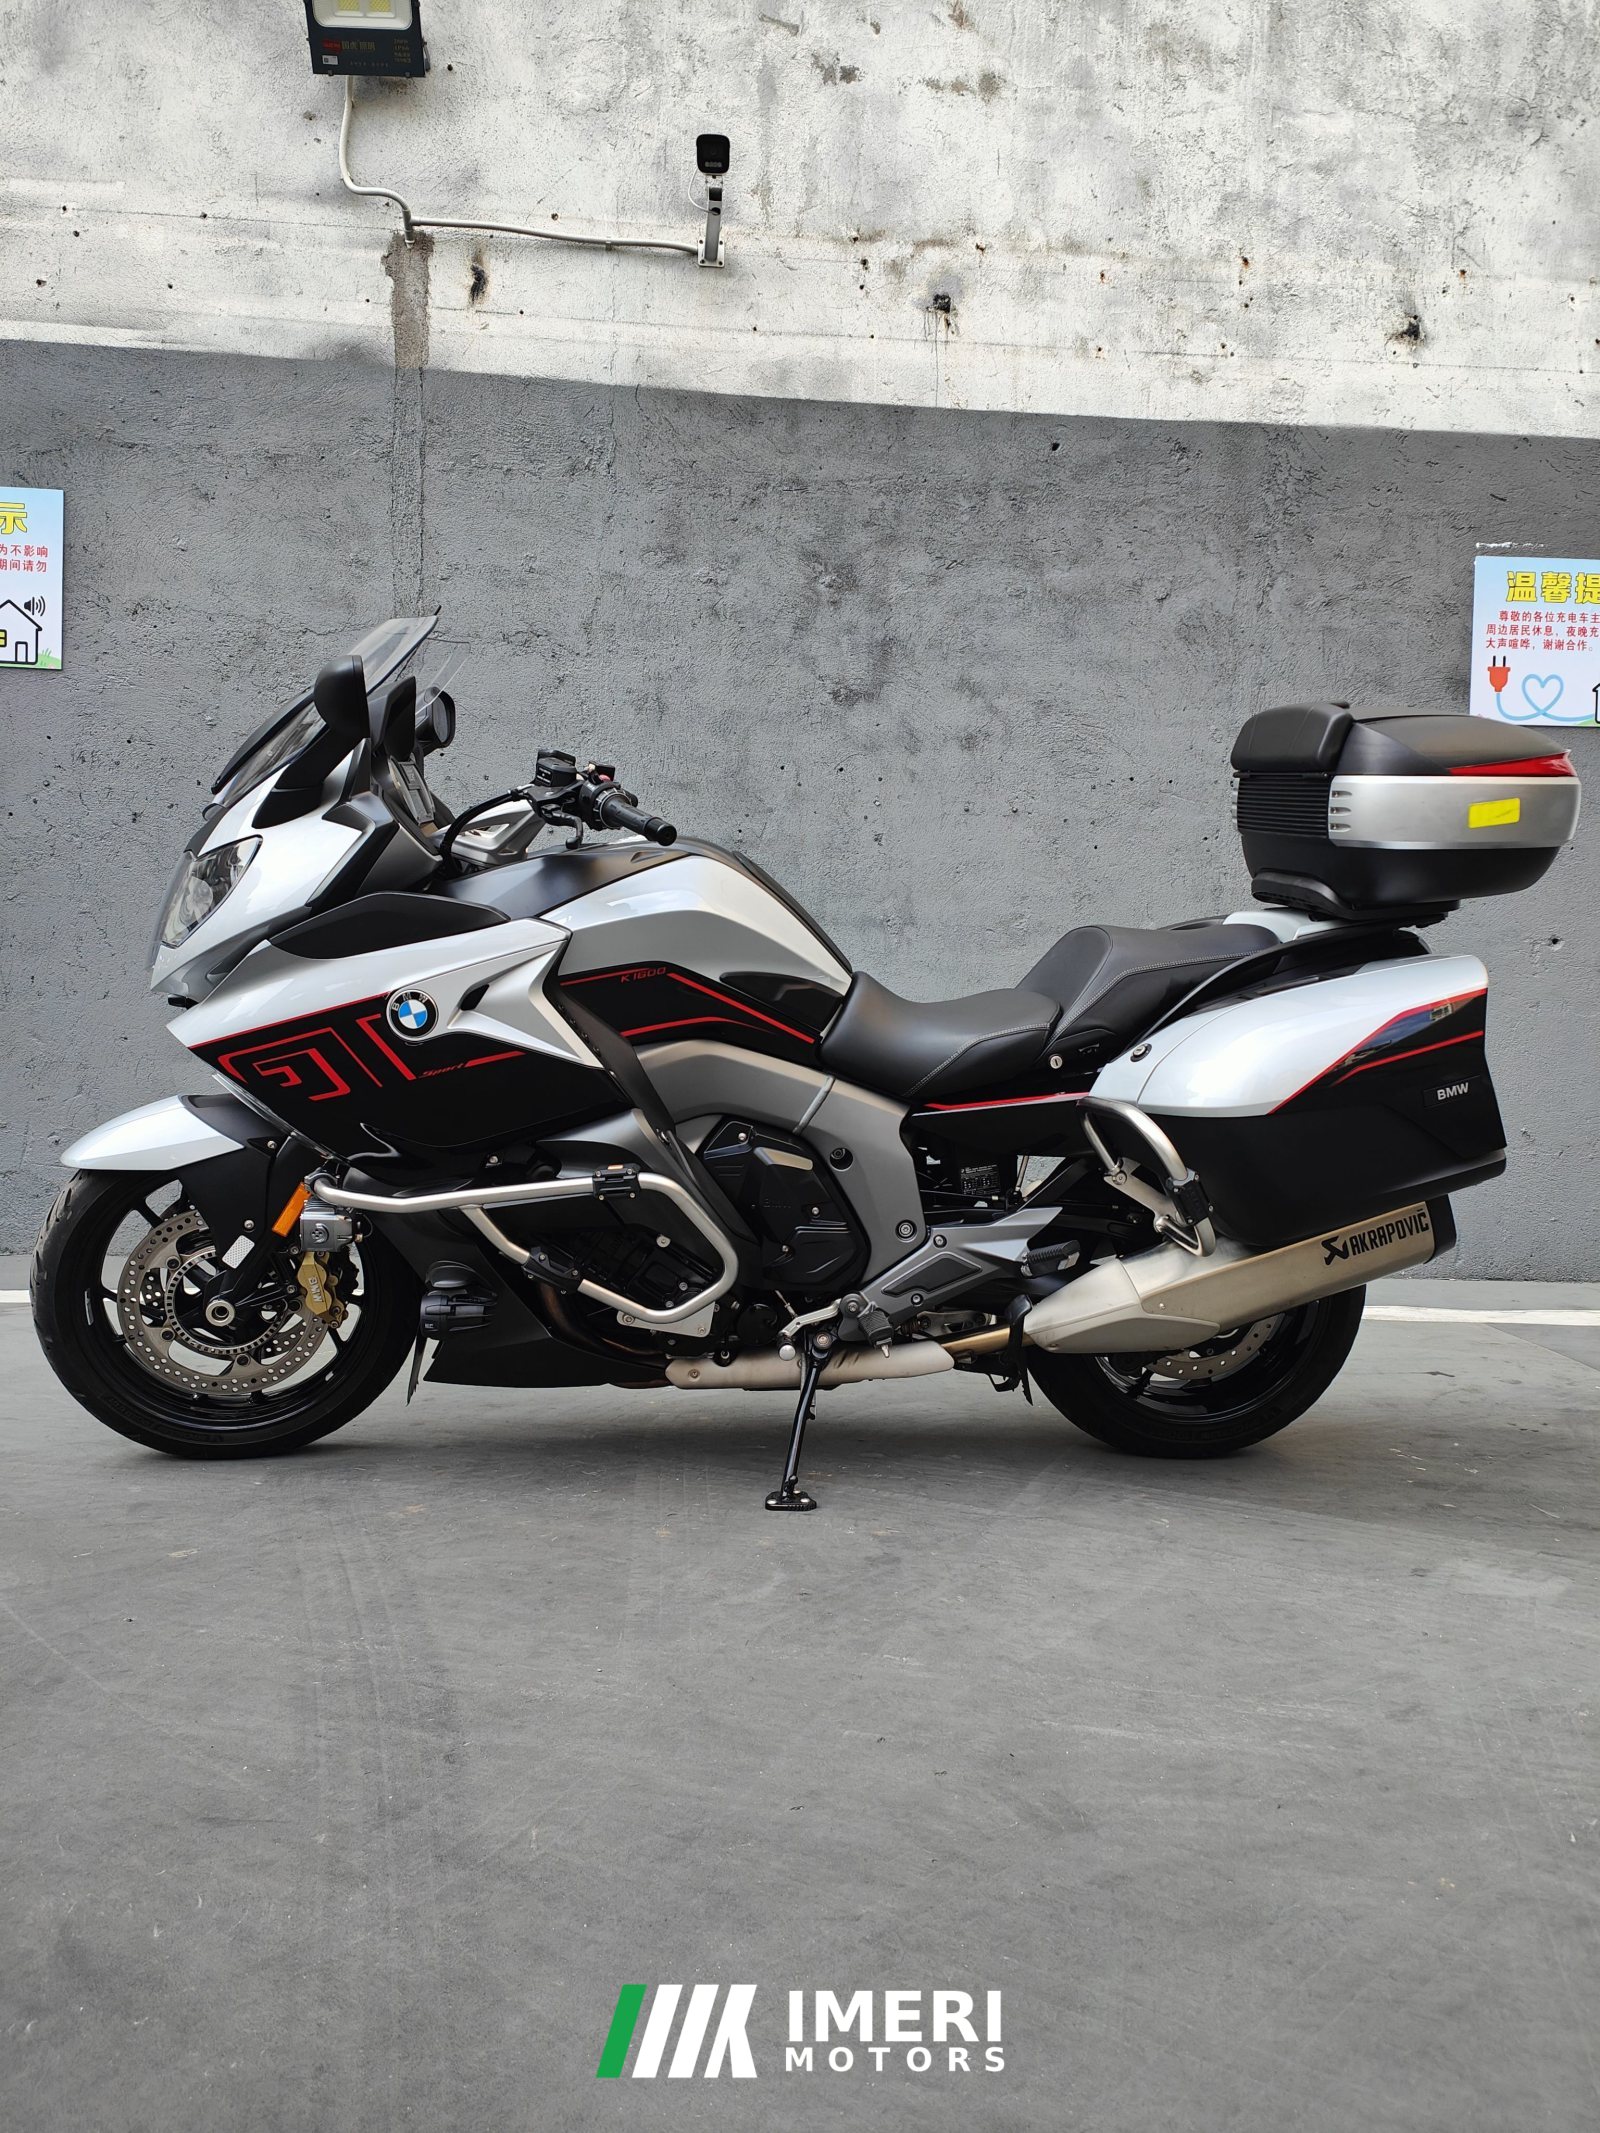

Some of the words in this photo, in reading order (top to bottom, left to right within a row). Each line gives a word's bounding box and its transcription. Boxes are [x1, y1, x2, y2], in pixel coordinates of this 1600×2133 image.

[1506, 571, 1600, 604] 温馨提
[391, 991, 429, 1012] BMW
[1436, 1082, 1469, 1101] BMW
[308, 1277, 323, 1302] BMW
